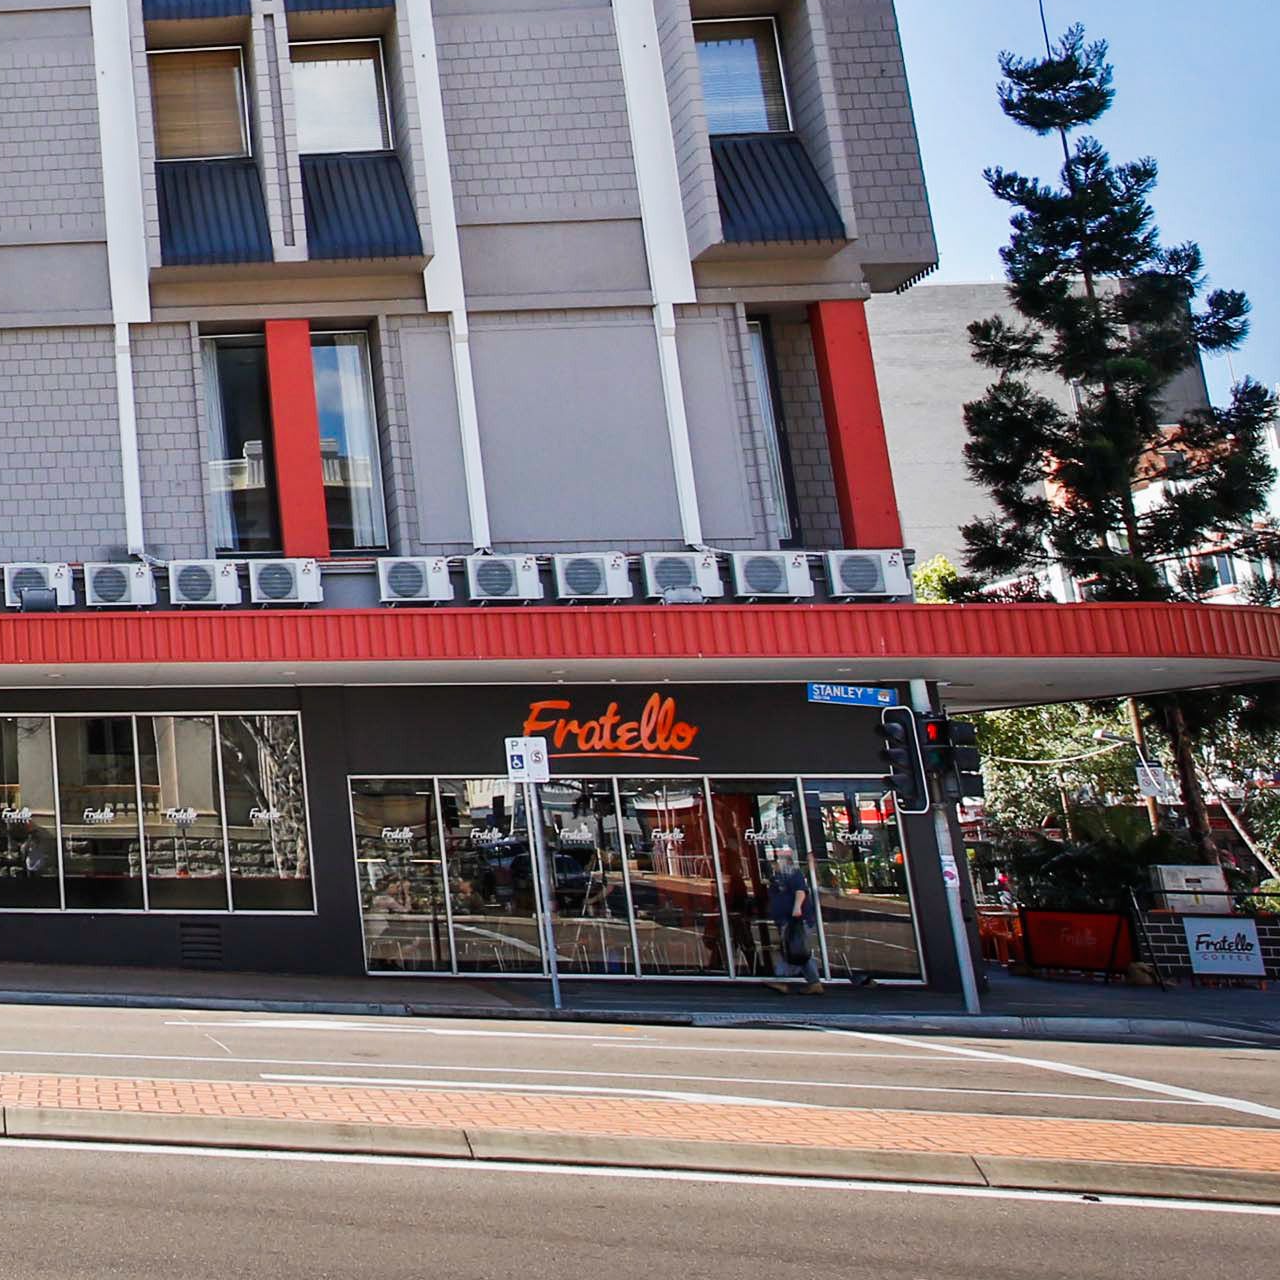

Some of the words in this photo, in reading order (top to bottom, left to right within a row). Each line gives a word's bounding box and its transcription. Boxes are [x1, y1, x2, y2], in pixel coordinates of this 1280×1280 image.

[812, 683, 864, 699] STANLEY
[523, 692, 700, 752] Fratello
[511, 740, 519, 750] P
[1195, 933, 1255, 952] Fratello
[1201, 953, 1252, 961] COFFEE
